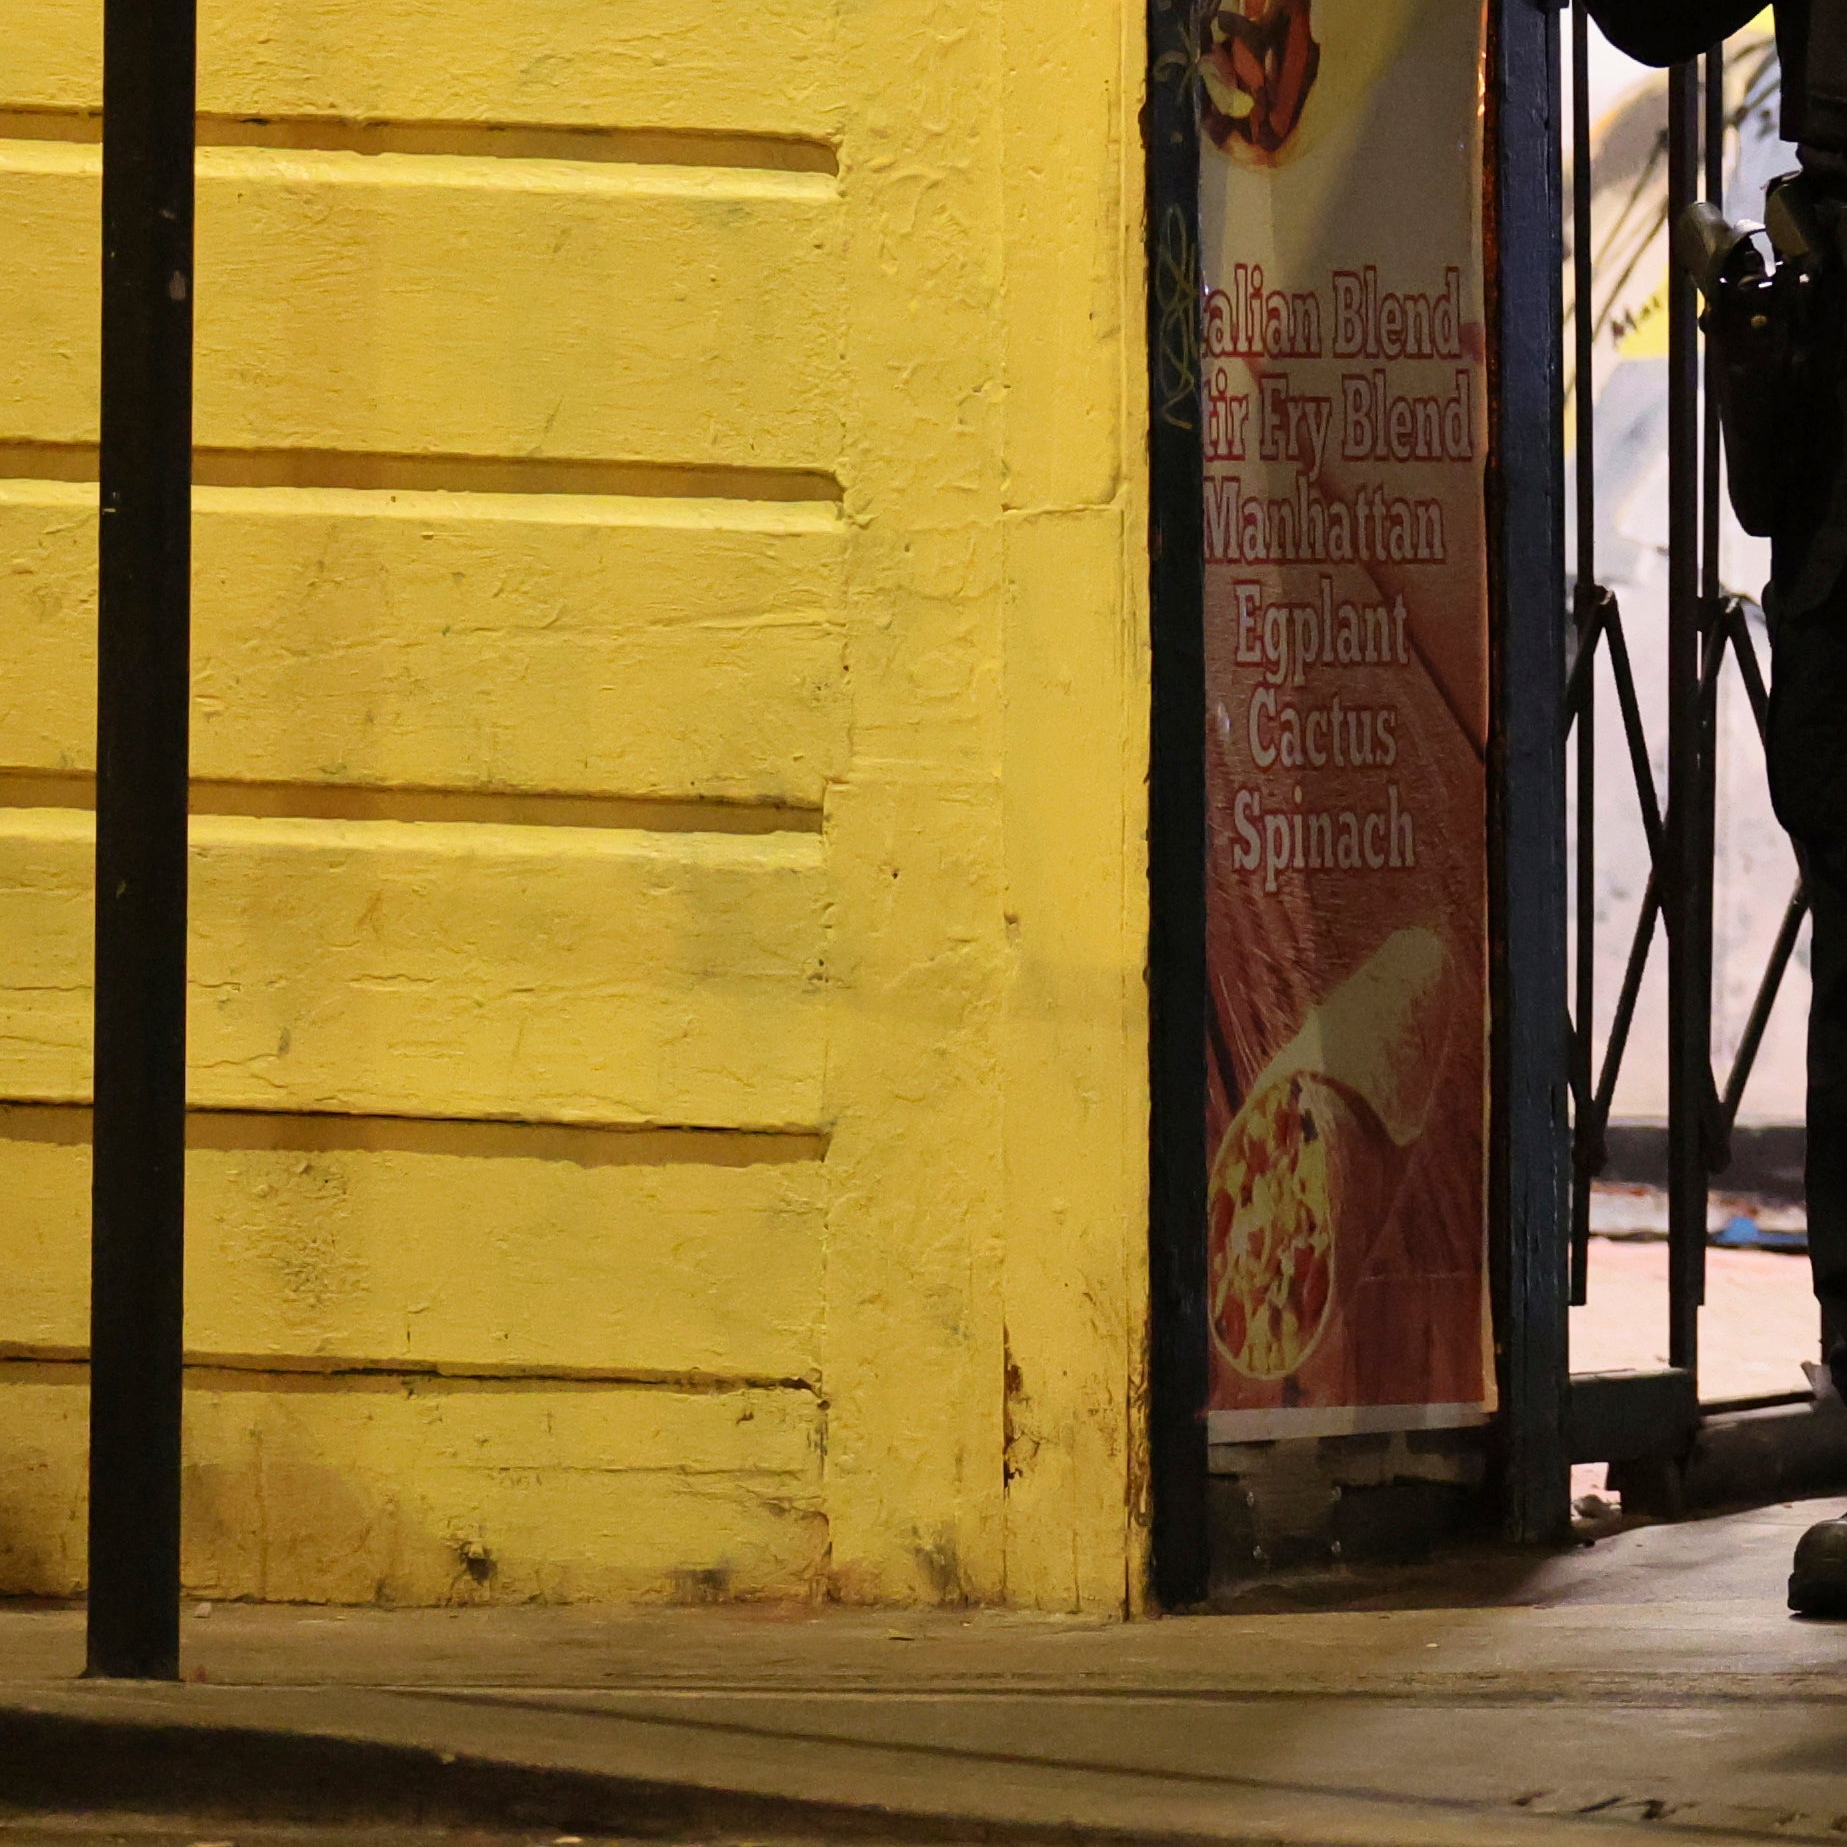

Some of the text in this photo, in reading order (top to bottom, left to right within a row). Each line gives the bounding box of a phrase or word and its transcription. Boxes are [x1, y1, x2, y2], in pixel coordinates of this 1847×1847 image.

[1201, 263, 1462, 360] alian Blend
[1259, 372, 1333, 484] Fry
[1341, 368, 1474, 461] Blend
[1202, 472, 1447, 565] Manhattan
[1233, 570, 1410, 689] Egplant
[1248, 682, 1399, 772] Cactus
[1232, 784, 1416, 893] Spinach
